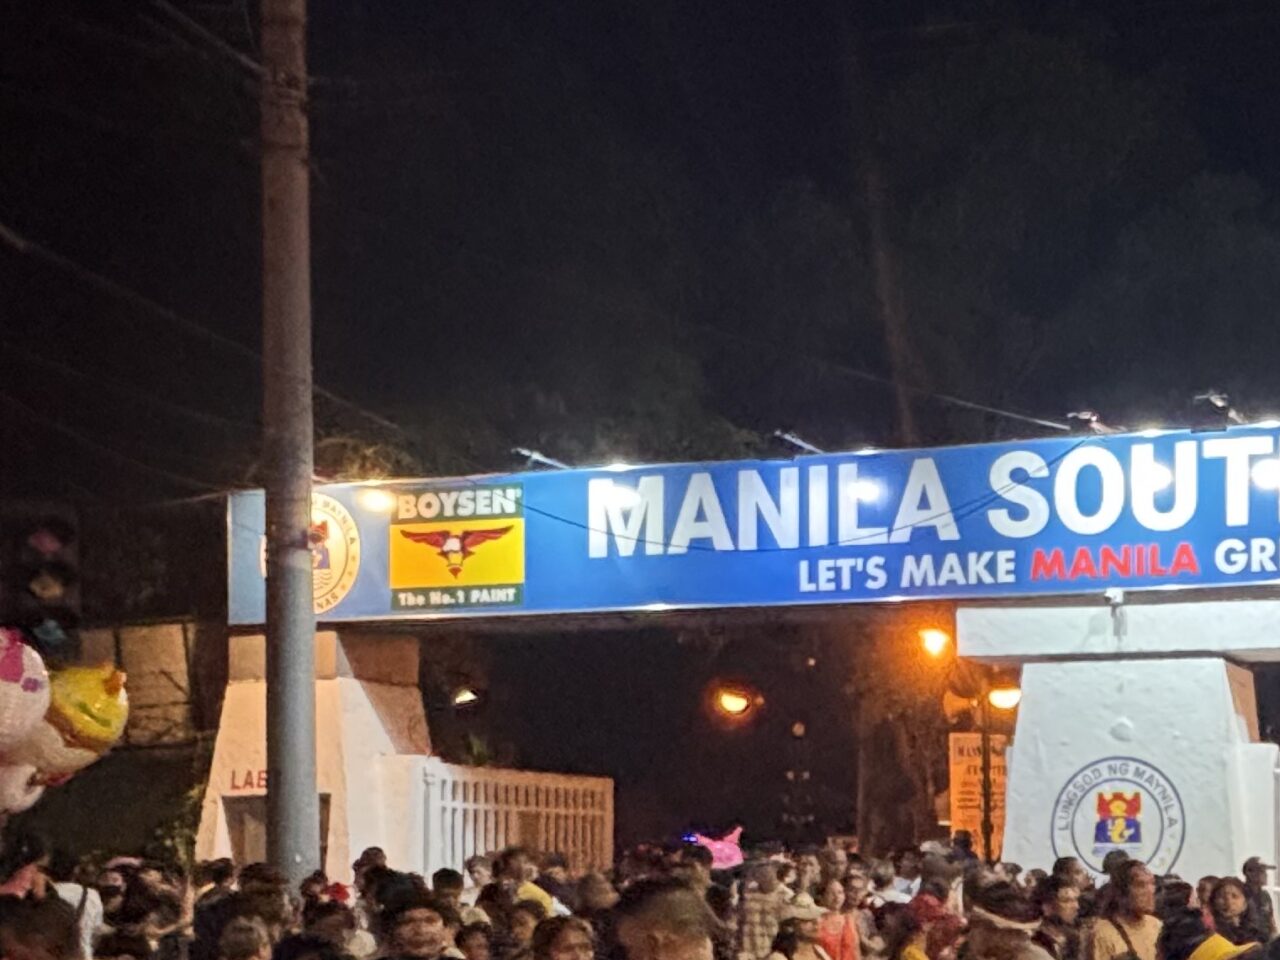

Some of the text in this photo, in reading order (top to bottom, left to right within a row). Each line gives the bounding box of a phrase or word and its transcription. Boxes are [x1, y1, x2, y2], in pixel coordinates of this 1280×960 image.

[398, 488, 518, 519] BOYSEN
[588, 457, 961, 559] MANILA
[799, 556, 888, 592] LET'S
[901, 550, 1016, 588] MAKE
[1030, 542, 1200, 581] MANILA
[398, 587, 516, 606] The No. 1 PAINT
[1058, 768, 1102, 831] LUNGSOD
[1107, 762, 1130, 776] NG
[1133, 766, 1178, 828] MAYNILA
